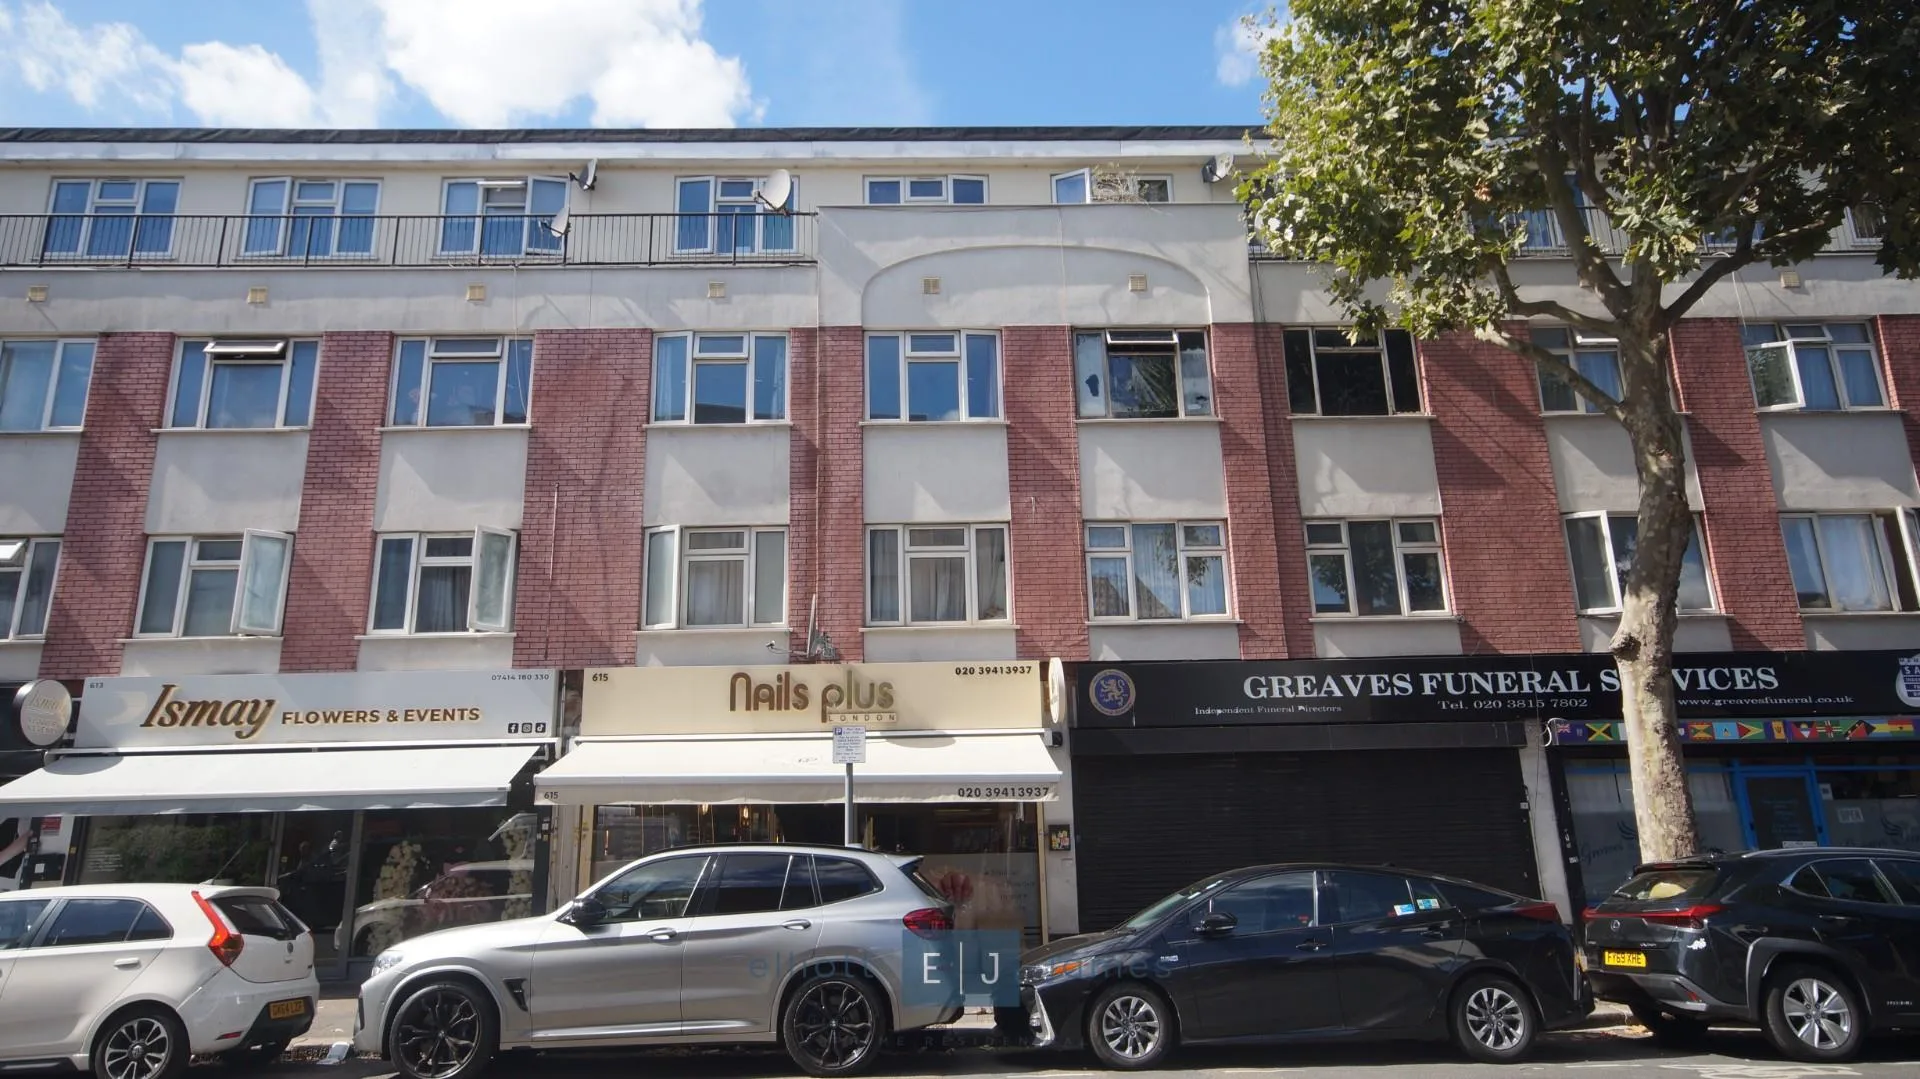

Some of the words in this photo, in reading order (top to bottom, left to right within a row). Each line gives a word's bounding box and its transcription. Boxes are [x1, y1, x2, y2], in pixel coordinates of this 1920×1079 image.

[955, 667, 975, 675] 020
[978, 666, 1032, 675] 39413937
[592, 673, 608, 682] 615
[1243, 673, 1413, 699] GREAVES
[1419, 670, 1591, 695] FUNERAL
[1599, 667, 1779, 692] SVICES
[729, 671, 810, 712] Nails
[821, 670, 894, 723] plus
[1438, 701, 1469, 710] Tel.
[1474, 700, 1502, 709] 020
[1507, 699, 1545, 709] 3815
[1550, 698, 1588, 708] 7802
[139, 684, 277, 740] Ismay
[282, 710, 380, 724] FLOWERS
[386, 709, 398, 723] &
[404, 707, 480, 722] EVENTS
[828, 714, 895, 722] LONDON
[544, 791, 558, 799] 615
[958, 788, 981, 797] 020
[985, 787, 1049, 797] 39413937
